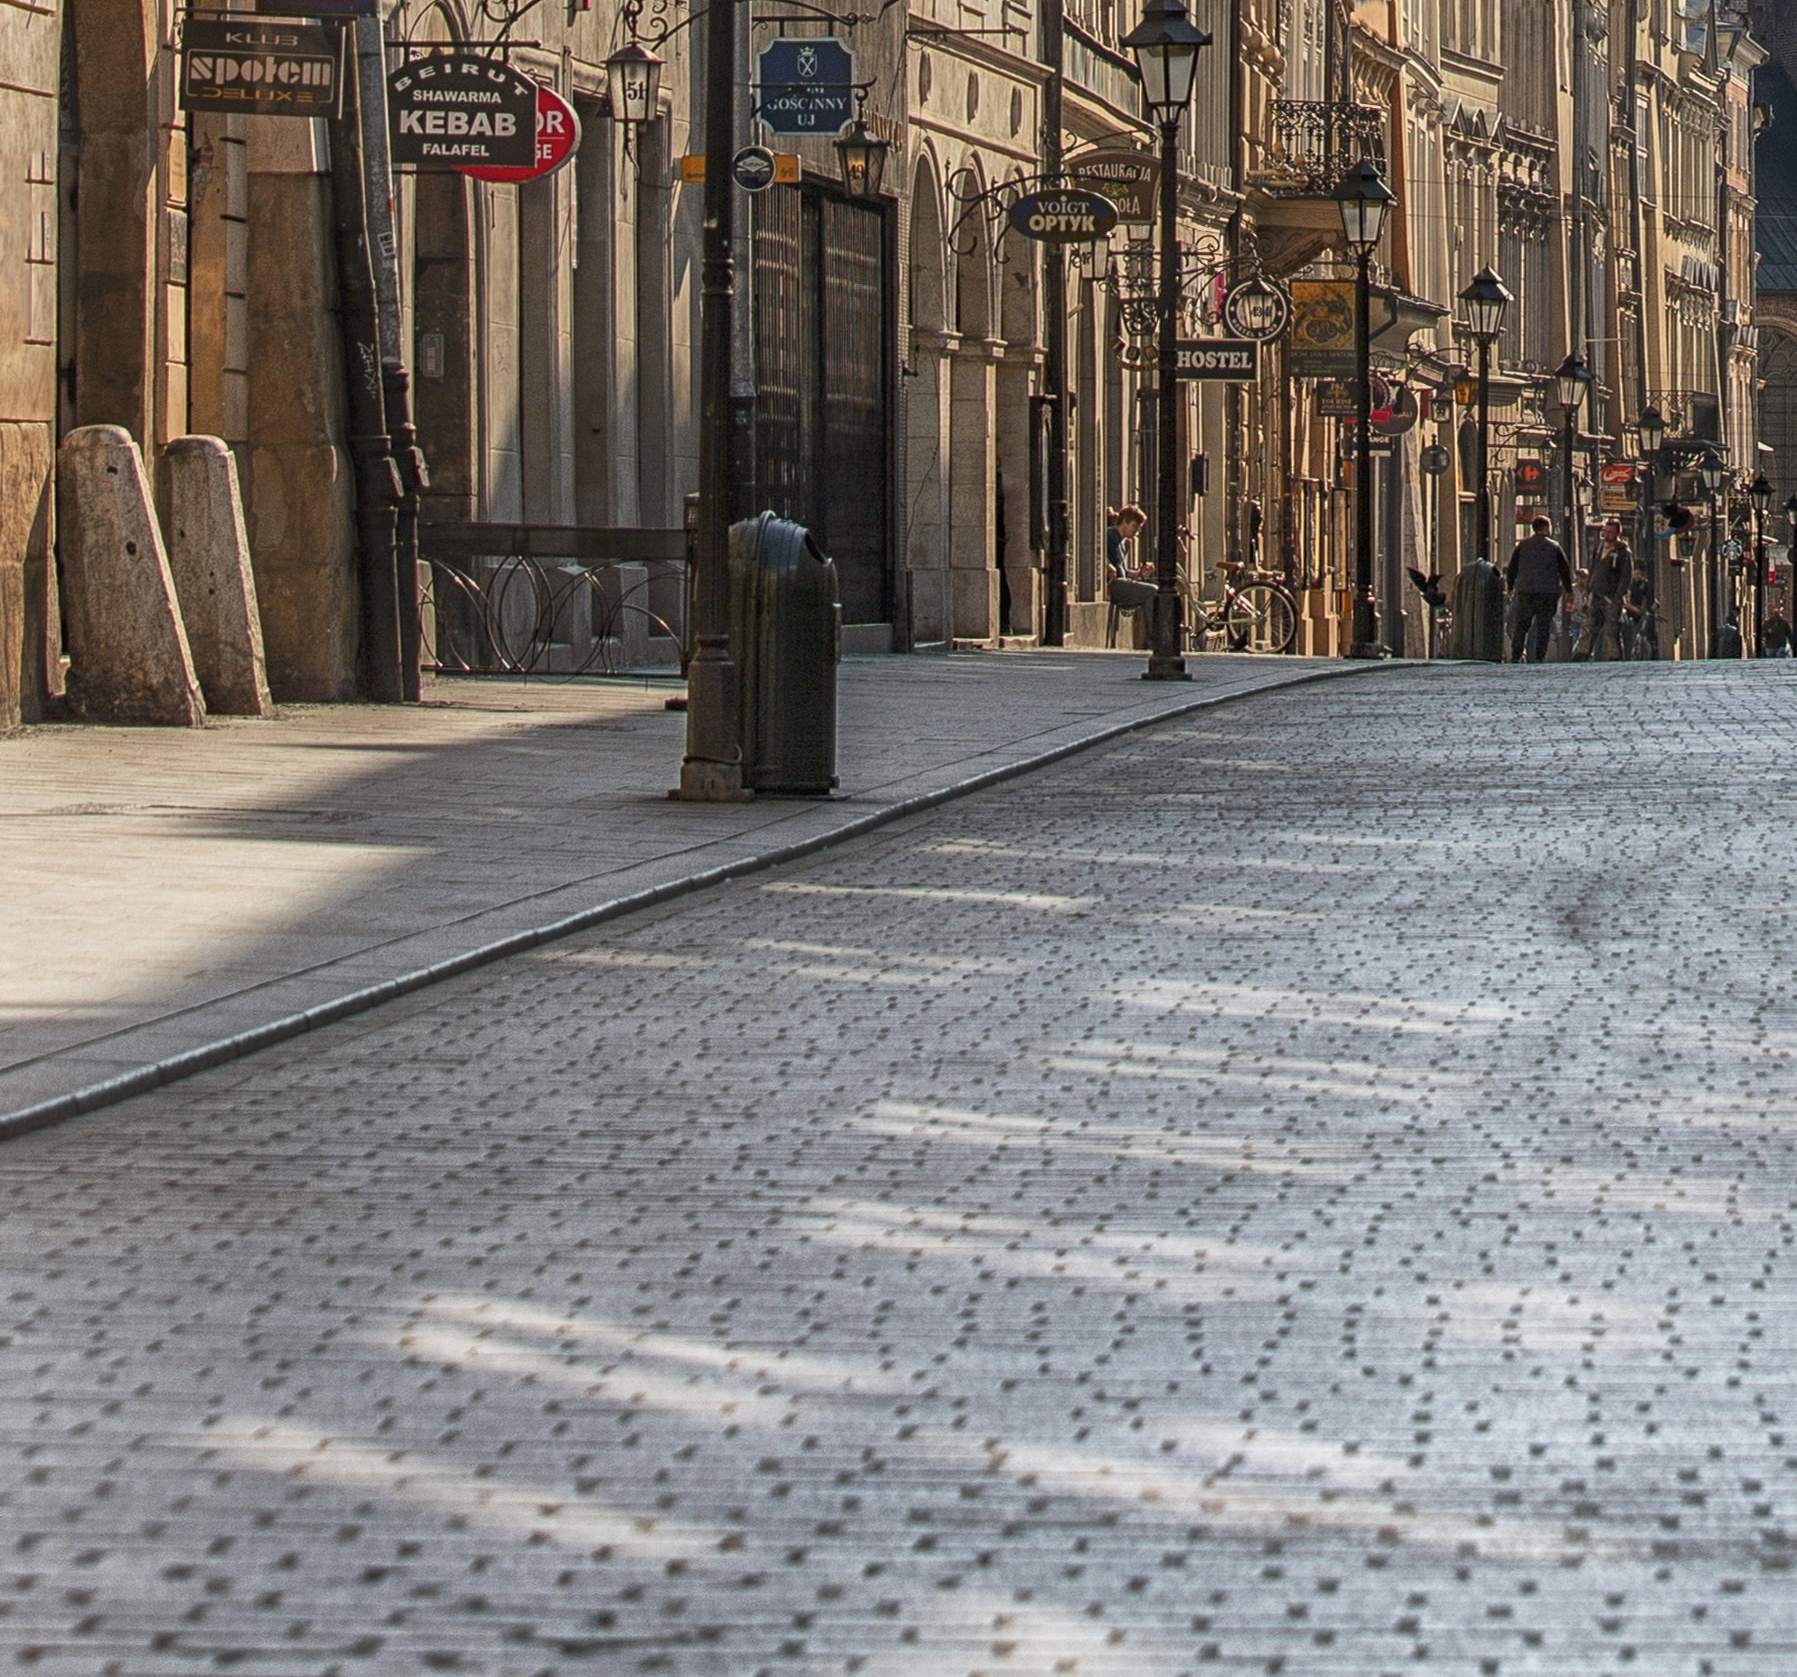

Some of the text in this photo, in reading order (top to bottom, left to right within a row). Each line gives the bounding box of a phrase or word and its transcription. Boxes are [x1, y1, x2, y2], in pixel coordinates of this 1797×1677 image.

[225, 32, 299, 46] KLUB
[394, 63, 529, 96] BEIRUT
[202, 86, 314, 103] DELUXE
[412, 89, 502, 104] SHAWARMA
[400, 109, 517, 137] KEBAB
[797, 114, 816, 126] UJ
[422, 143, 490, 157] FALAFEL
[1028, 214, 1096, 232] OPTYK
[1176, 350, 1253, 369] HOSTEL
